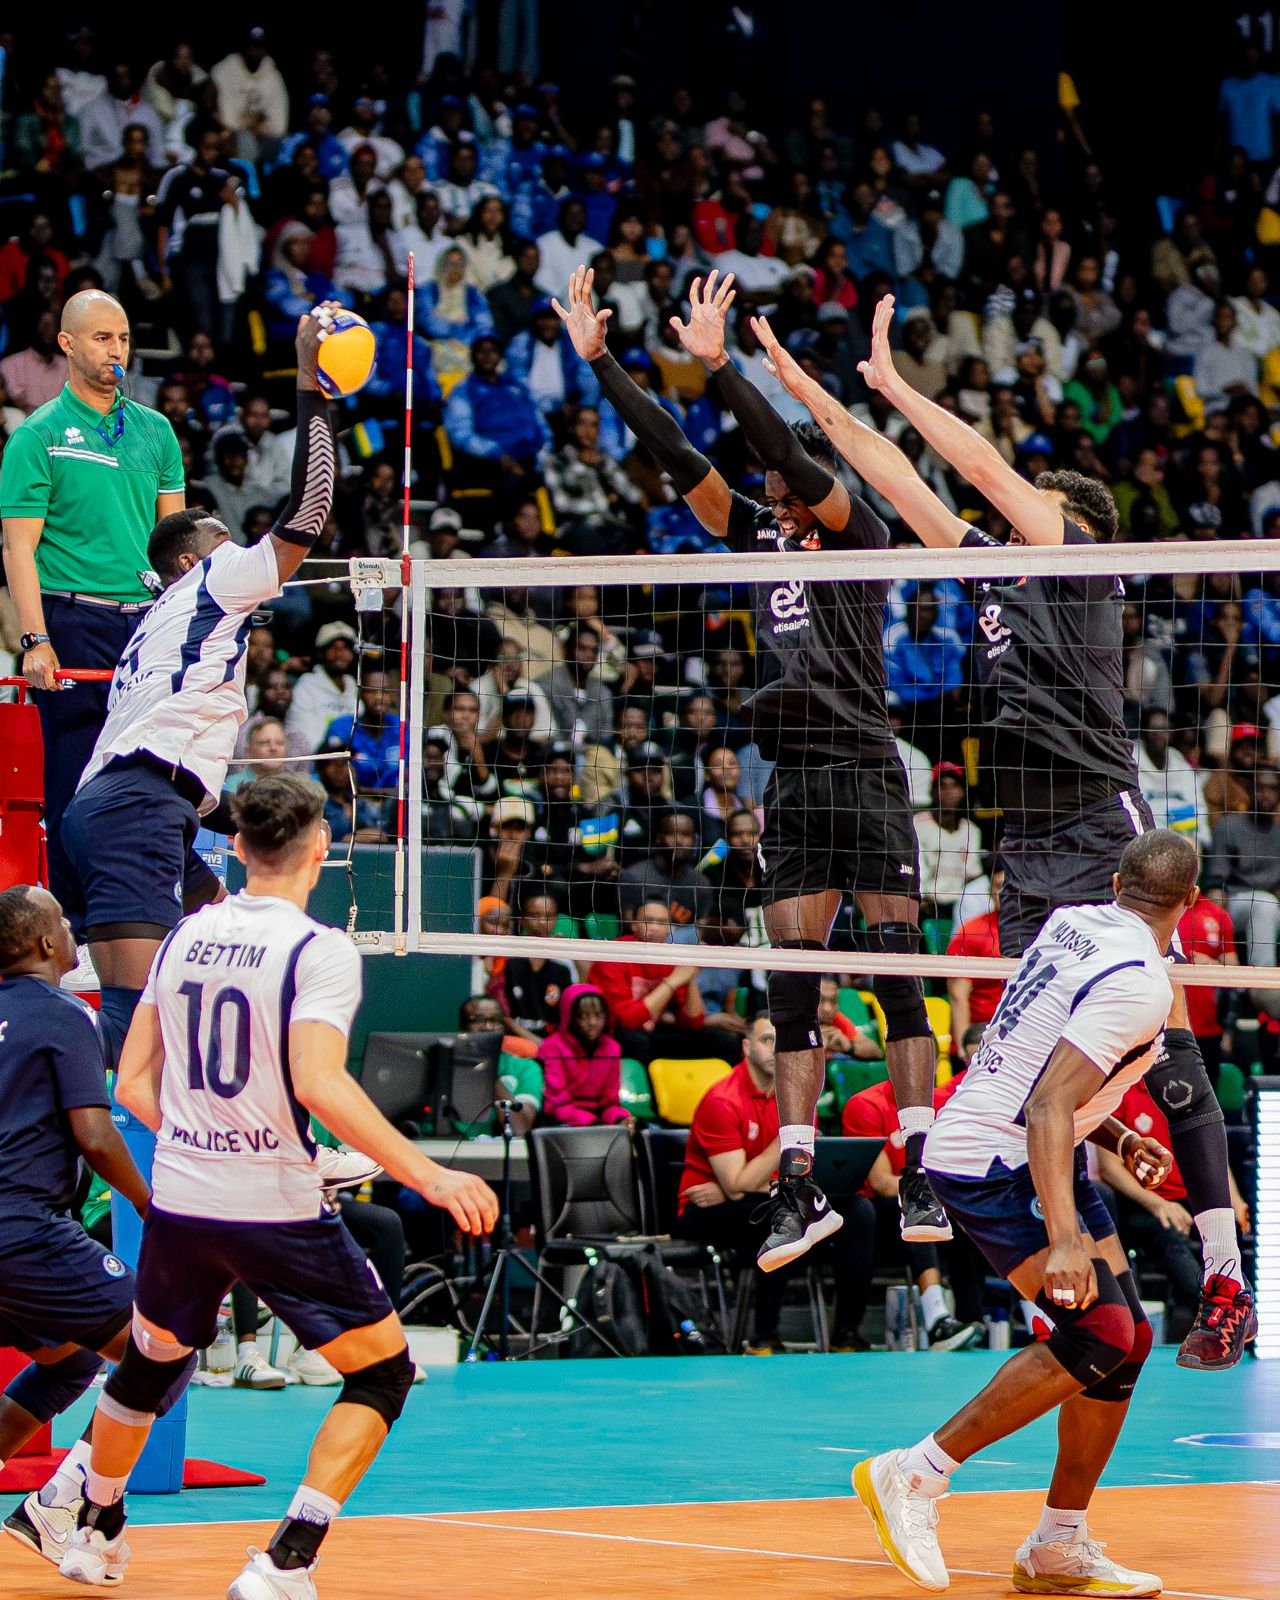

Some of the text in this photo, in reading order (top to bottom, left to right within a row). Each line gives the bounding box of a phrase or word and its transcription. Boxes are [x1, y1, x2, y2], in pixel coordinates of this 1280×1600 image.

[757, 529, 777, 539] JAKO
[184, 940, 267, 968] BETTIM
[176, 979, 251, 1099] 10
[111, 1113, 126, 1122] noh
[243, 1126, 280, 1153] VC
